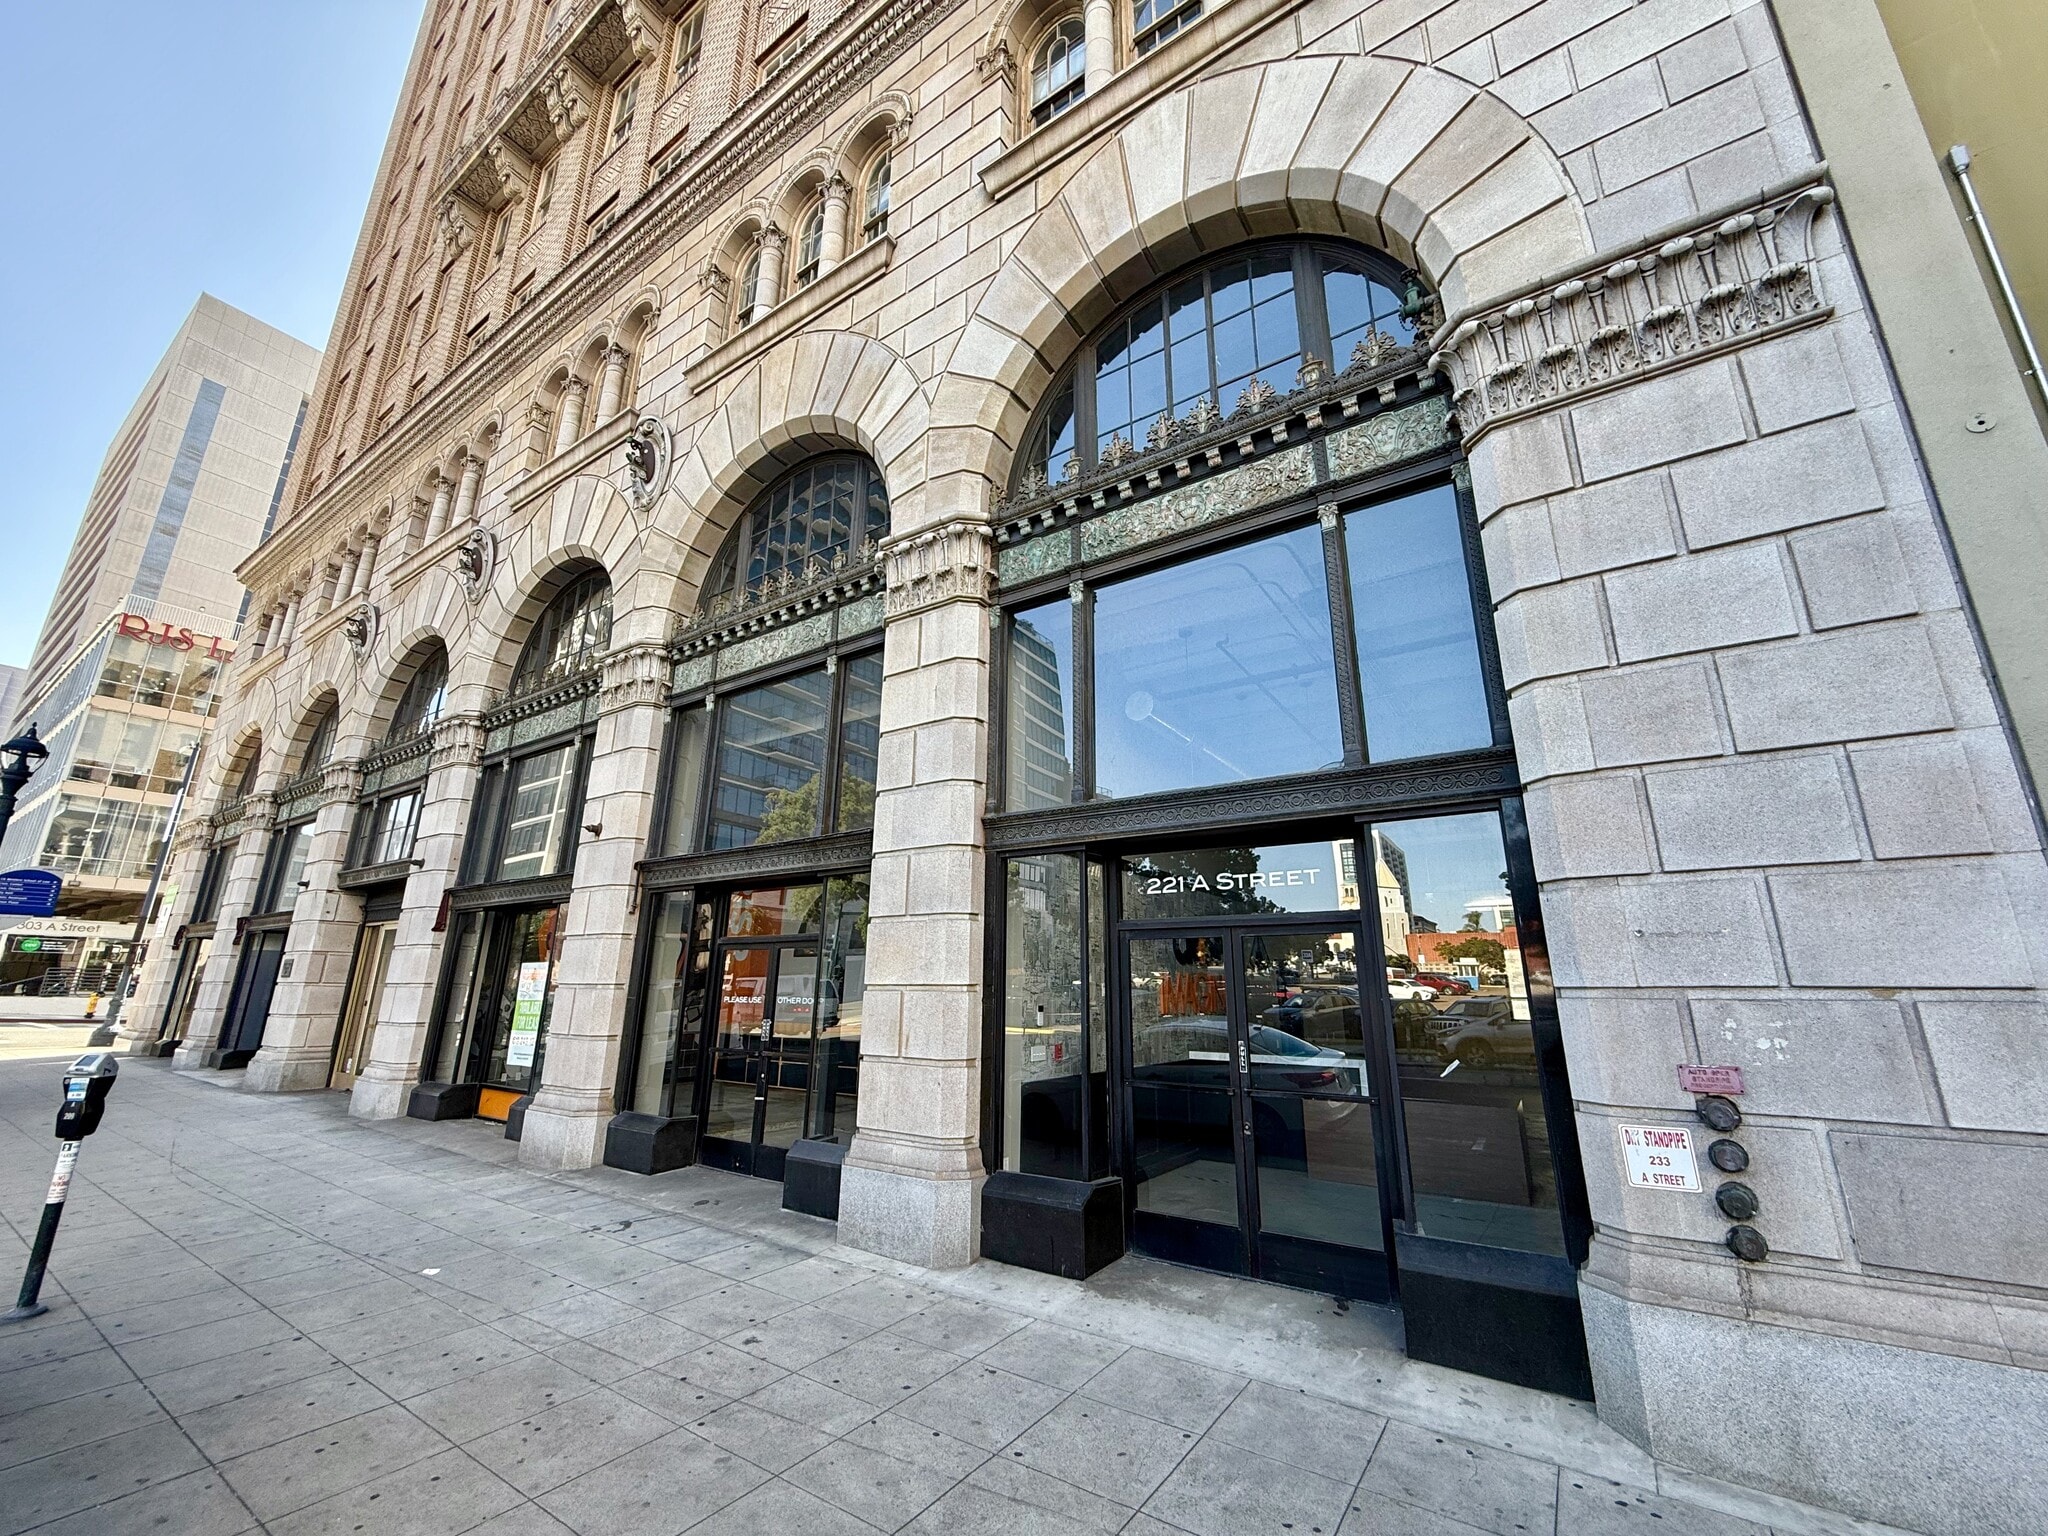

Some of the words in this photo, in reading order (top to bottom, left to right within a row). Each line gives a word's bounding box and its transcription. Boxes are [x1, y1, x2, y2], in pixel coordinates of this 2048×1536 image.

[115, 612, 194, 652] RJS
[1146, 876, 1184, 895] 221
[1191, 874, 1210, 892] A
[1216, 868, 1320, 891] STREET
[17, 921, 42, 931] 303
[45, 922, 57, 931] A
[60, 922, 102, 933] Street
[723, 995, 749, 1004] PLEASE
[748, 995, 763, 1004] USE
[777, 996, 801, 1005] OTHER
[1643, 1130, 1687, 1150] STANDPIPE
[1648, 1155, 1671, 1167] 233
[1642, 1172, 1649, 1183] A
[1652, 1173, 1686, 1187] STREET
